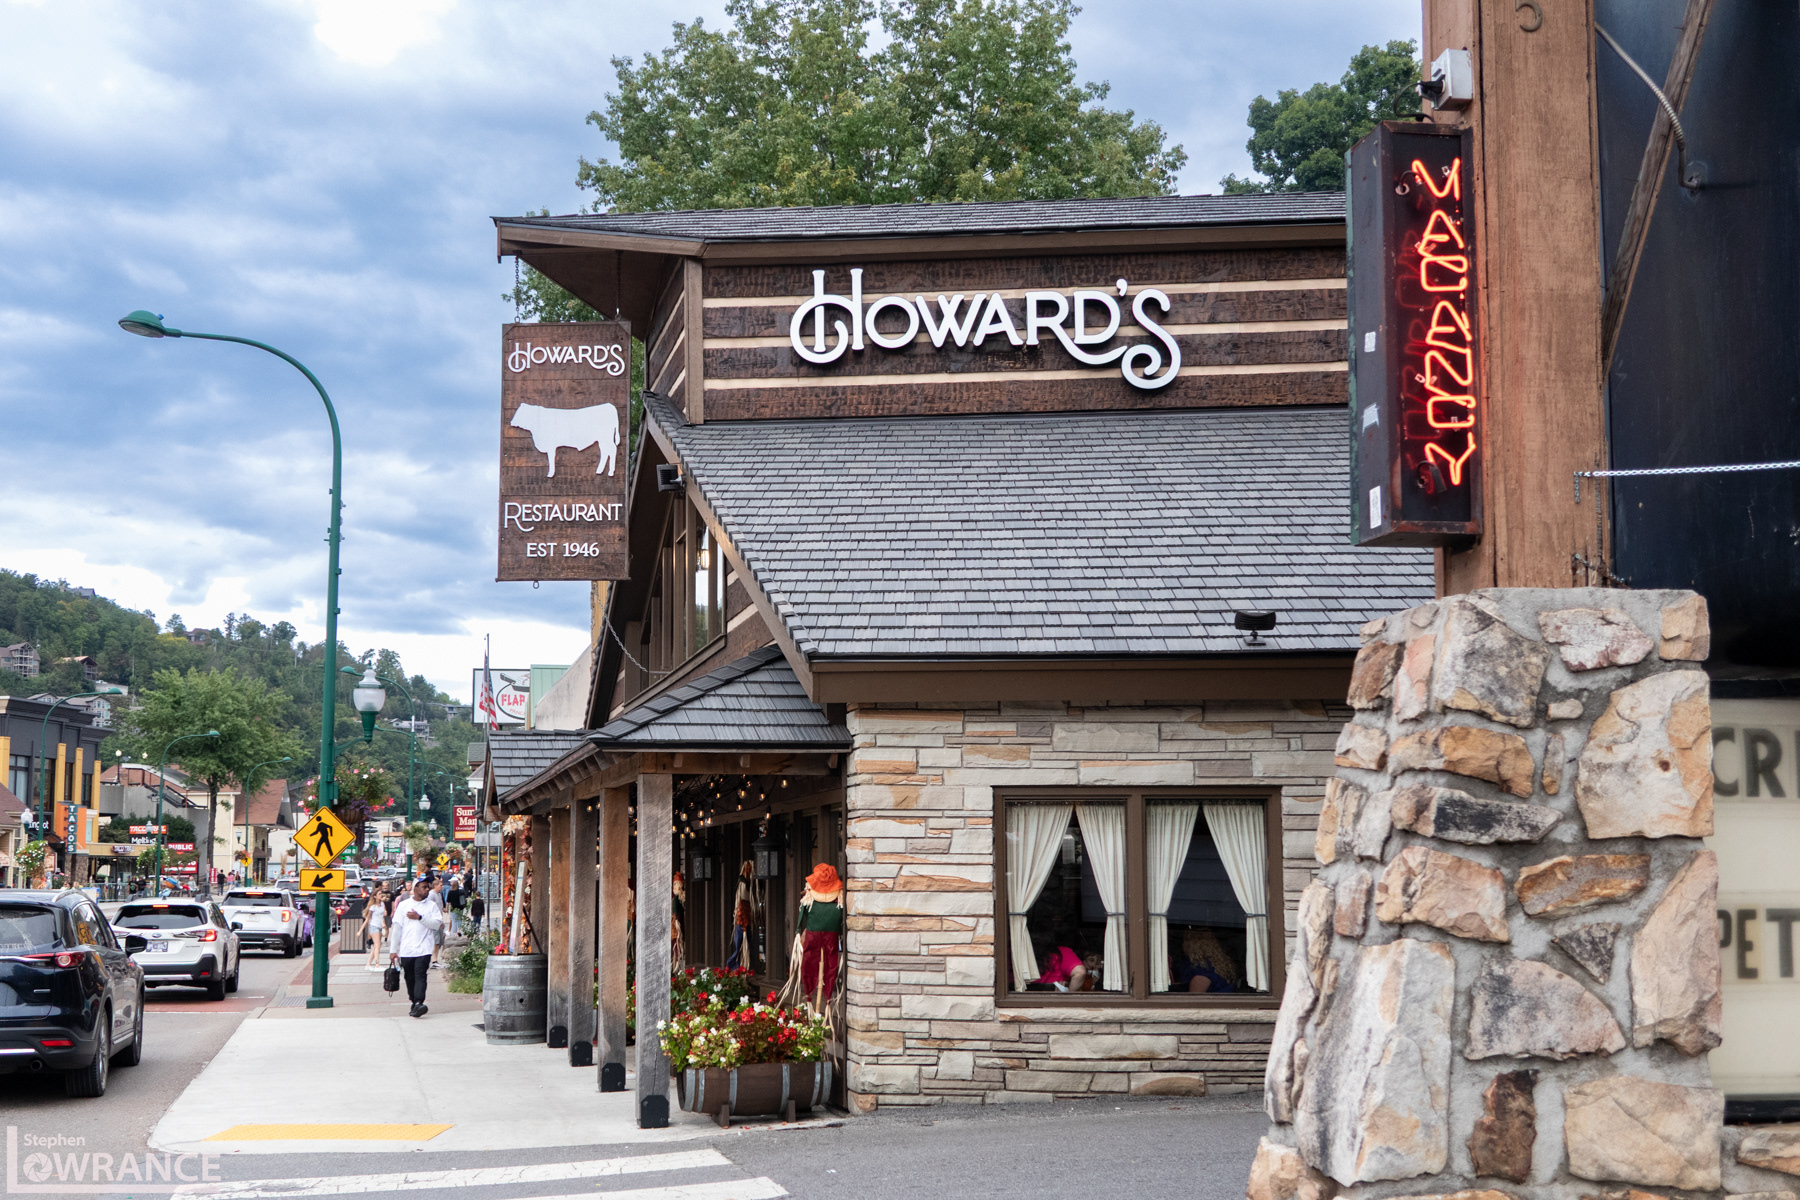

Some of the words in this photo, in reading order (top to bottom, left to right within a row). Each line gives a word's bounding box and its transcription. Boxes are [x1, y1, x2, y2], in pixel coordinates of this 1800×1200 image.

[789, 268, 1181, 390] HOWARD'S
[1411, 157, 1476, 486] VACANCY
[507, 342, 626, 377] HOWARD'S
[503, 502, 623, 532] RESTAURANT
[526, 542, 557, 558] EST
[562, 542, 600, 558] 1946
[501, 694, 525, 706] FLAP
[67, 805, 76, 852] TACOS
